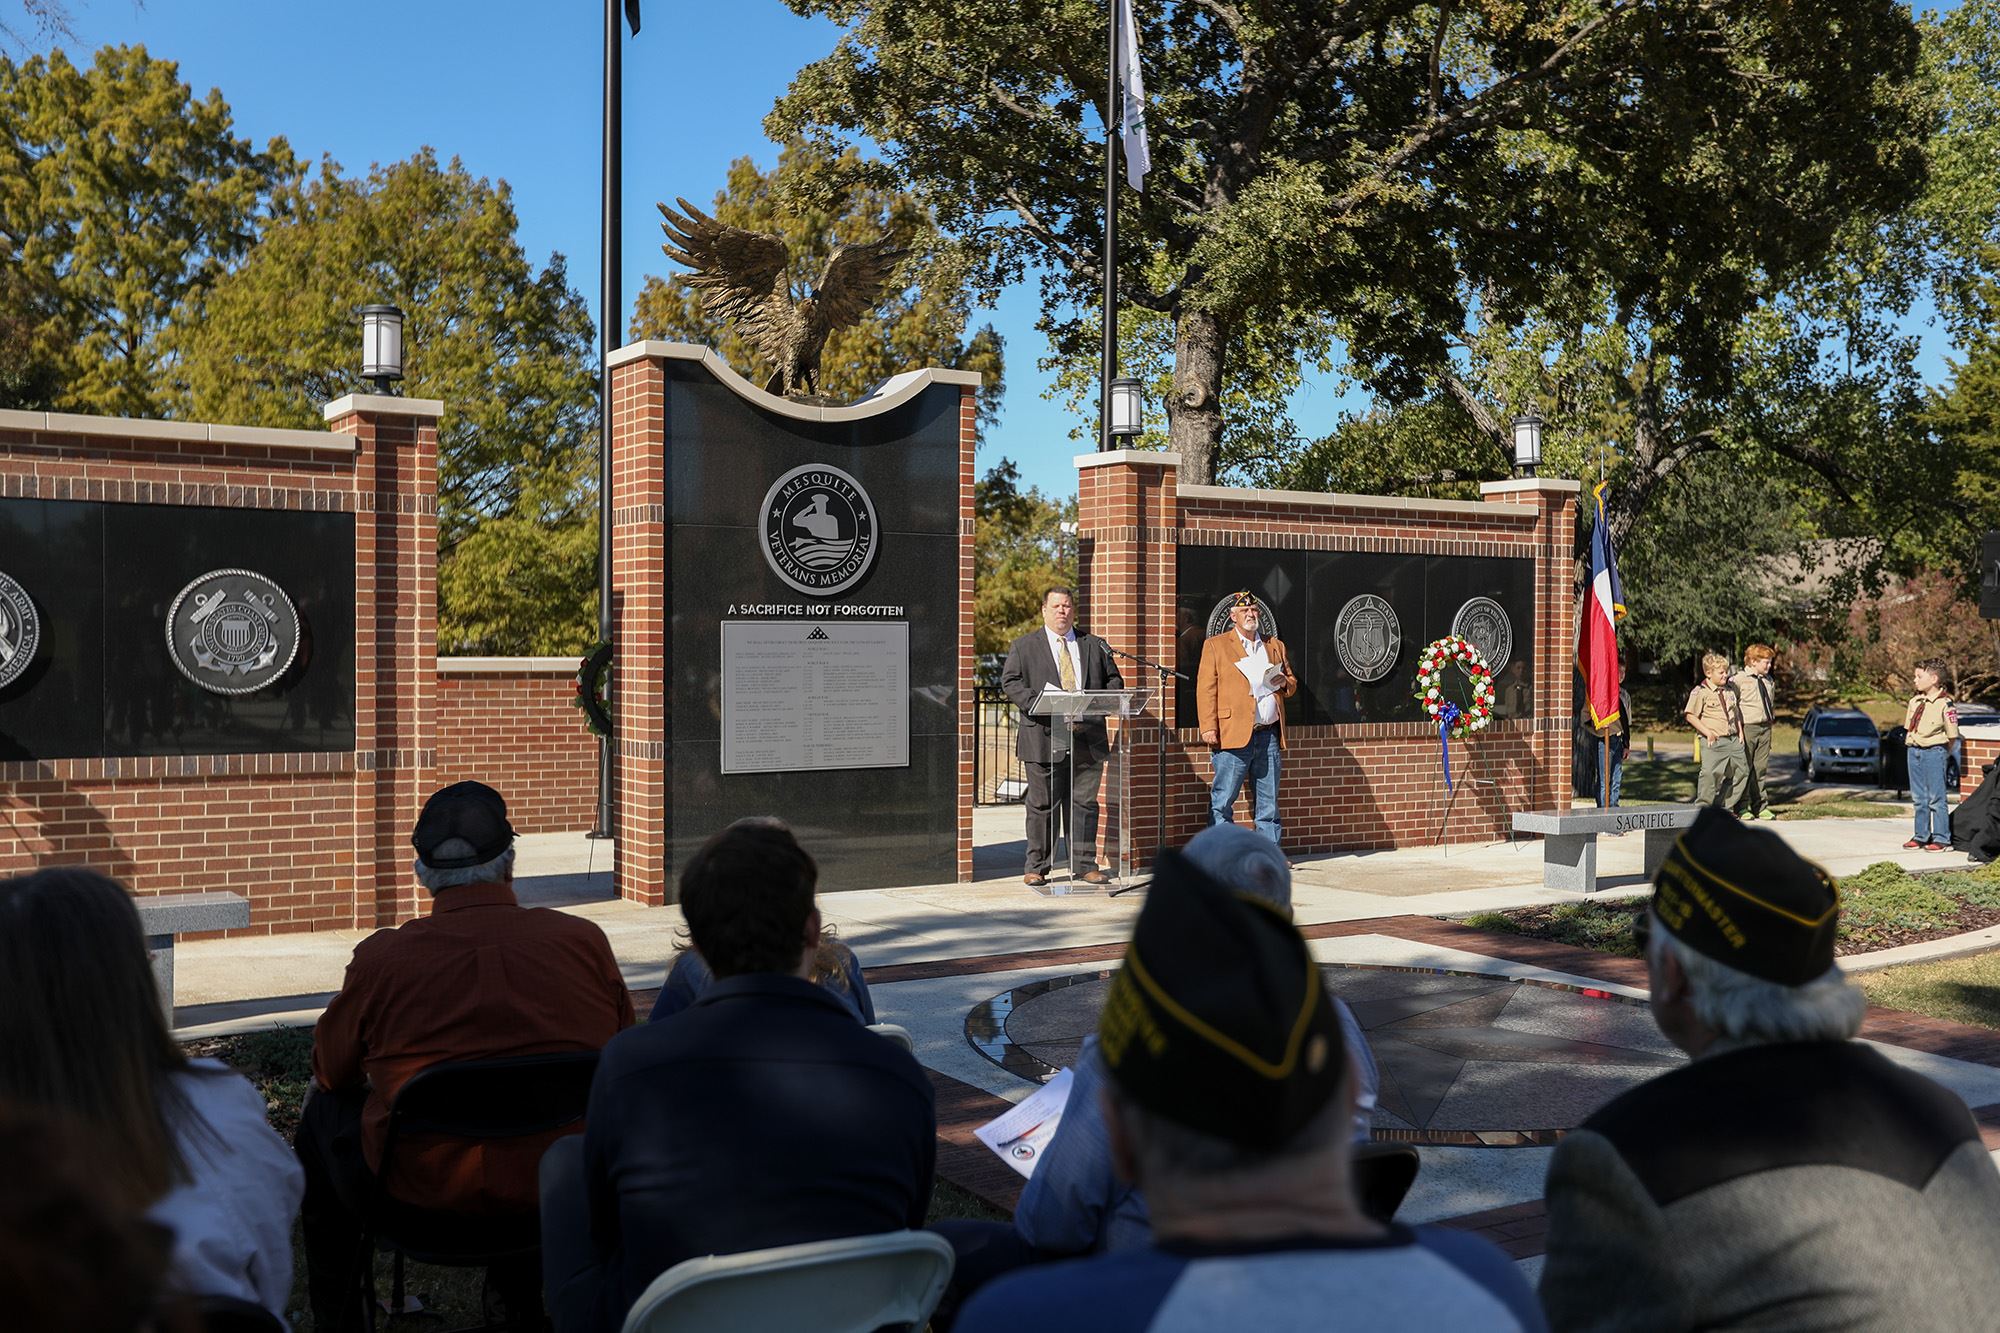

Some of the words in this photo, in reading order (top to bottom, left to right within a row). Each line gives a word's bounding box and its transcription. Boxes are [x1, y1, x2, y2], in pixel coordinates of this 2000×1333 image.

[782, 473, 857, 501] MESQUITE
[769, 530, 816, 585] VETERANS
[820, 534, 870, 585] MEMORIAL
[10, 592, 32, 620] ARMY
[728, 604, 737, 615] A
[740, 604, 803, 615] SACRIFICE
[806, 605, 831, 615] NOT
[833, 605, 904, 616] FORGOTTEN
[1342, 601, 1361, 625] UNITED
[1378, 602, 1397, 628] STATES
[1261, 614, 1273, 635] NAVY
[0, 634, 34, 681] AMERICA
[1339, 643, 1364, 677] MERCHANT
[1616, 813, 1675, 830] SACRIFICE
